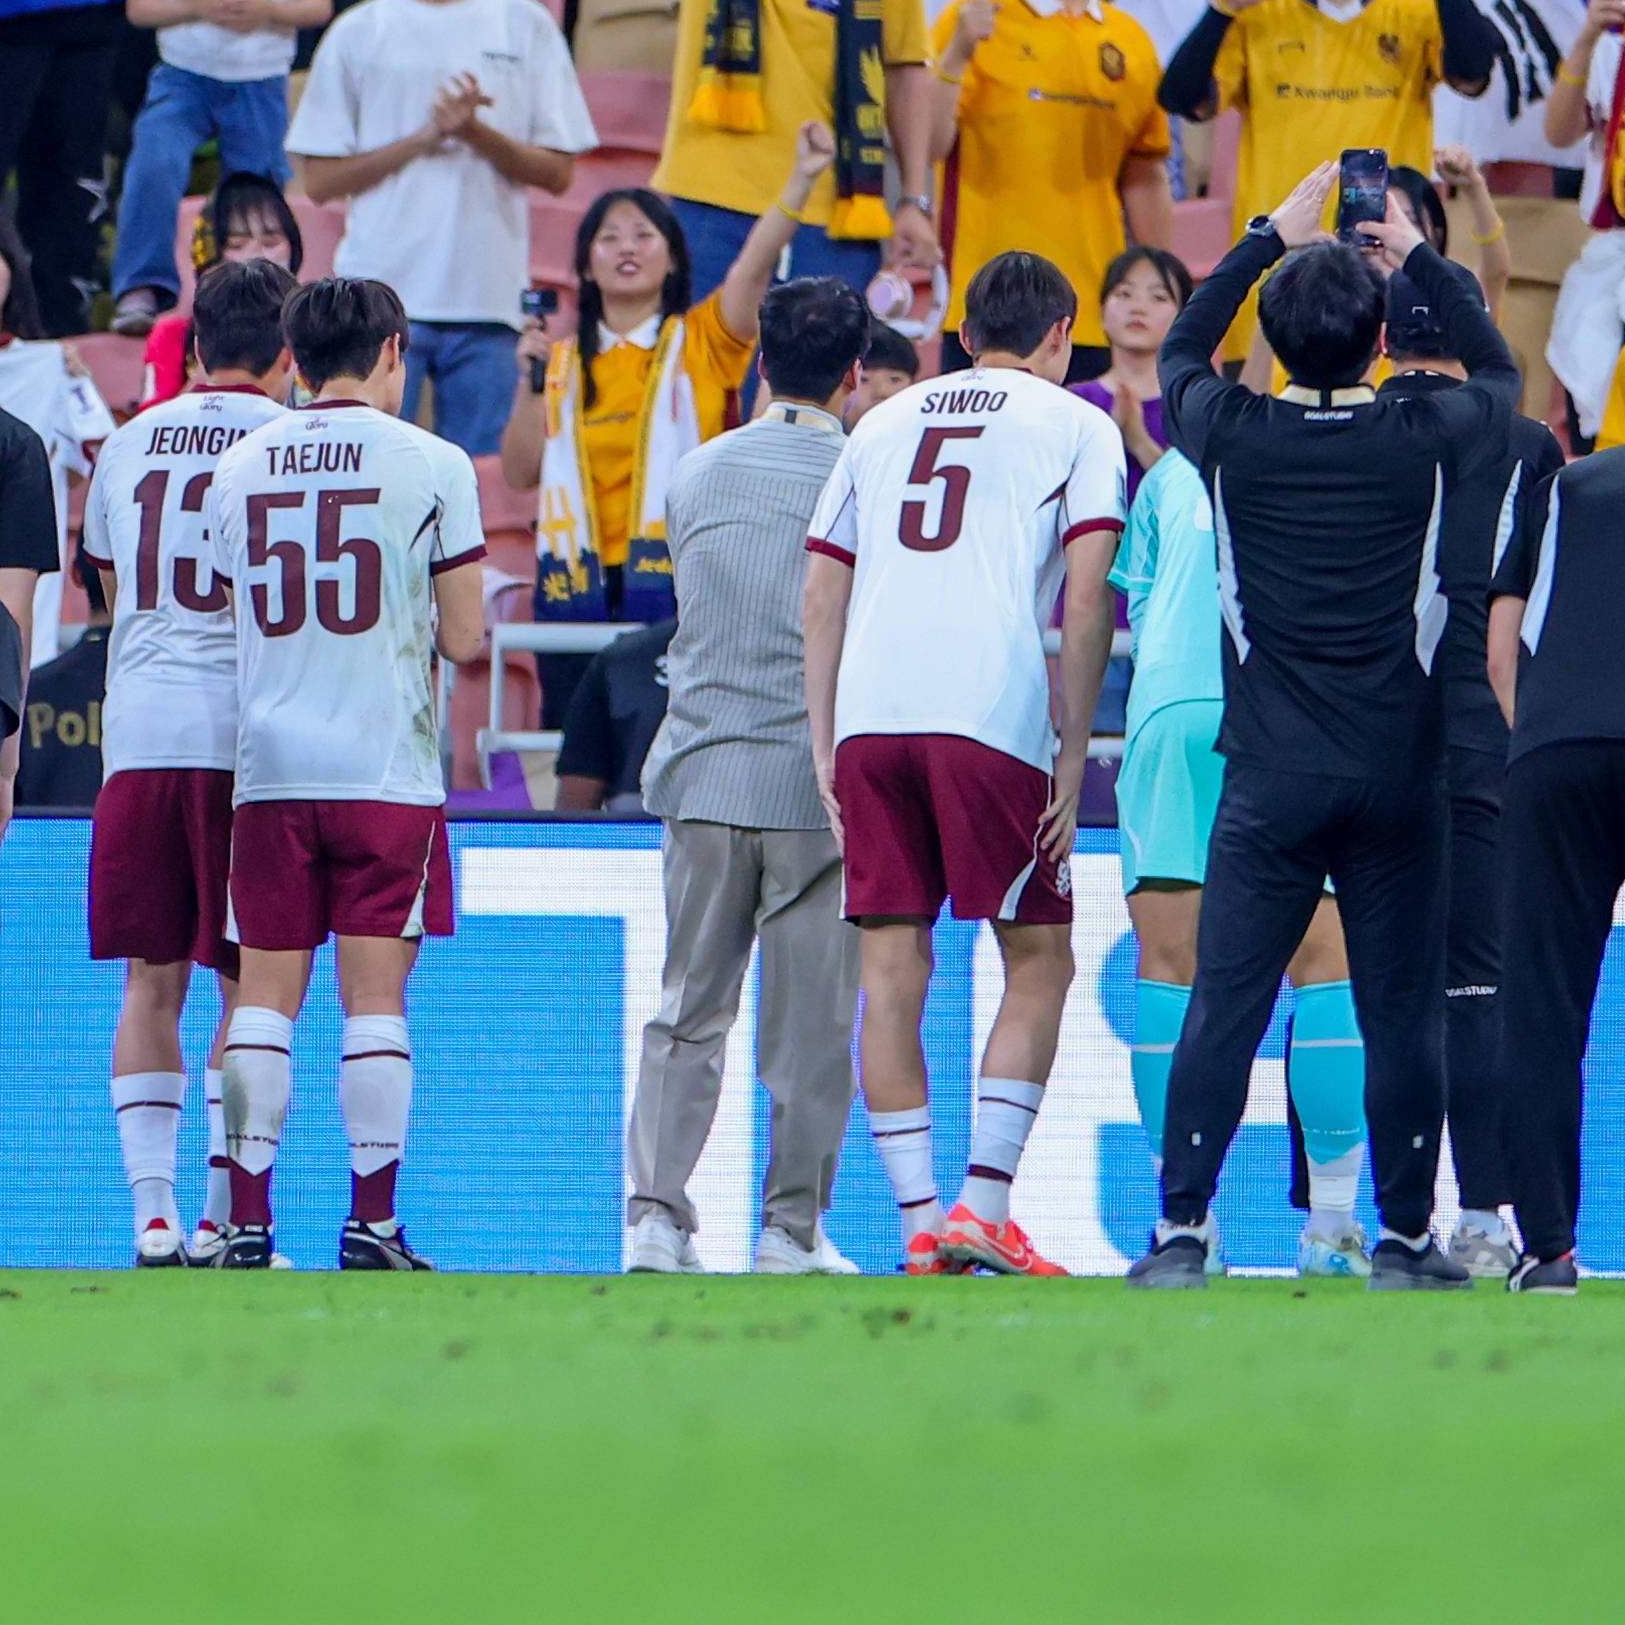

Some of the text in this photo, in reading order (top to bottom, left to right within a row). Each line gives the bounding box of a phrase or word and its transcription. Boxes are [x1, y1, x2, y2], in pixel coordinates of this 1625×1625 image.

[919, 390, 1008, 415] SIWOO
[265, 442, 363, 476] TAEJUN
[897, 425, 985, 553] 5
[133, 469, 232, 613] 13
[246, 487, 381, 638] 55
[27, 701, 101, 749] Pol
